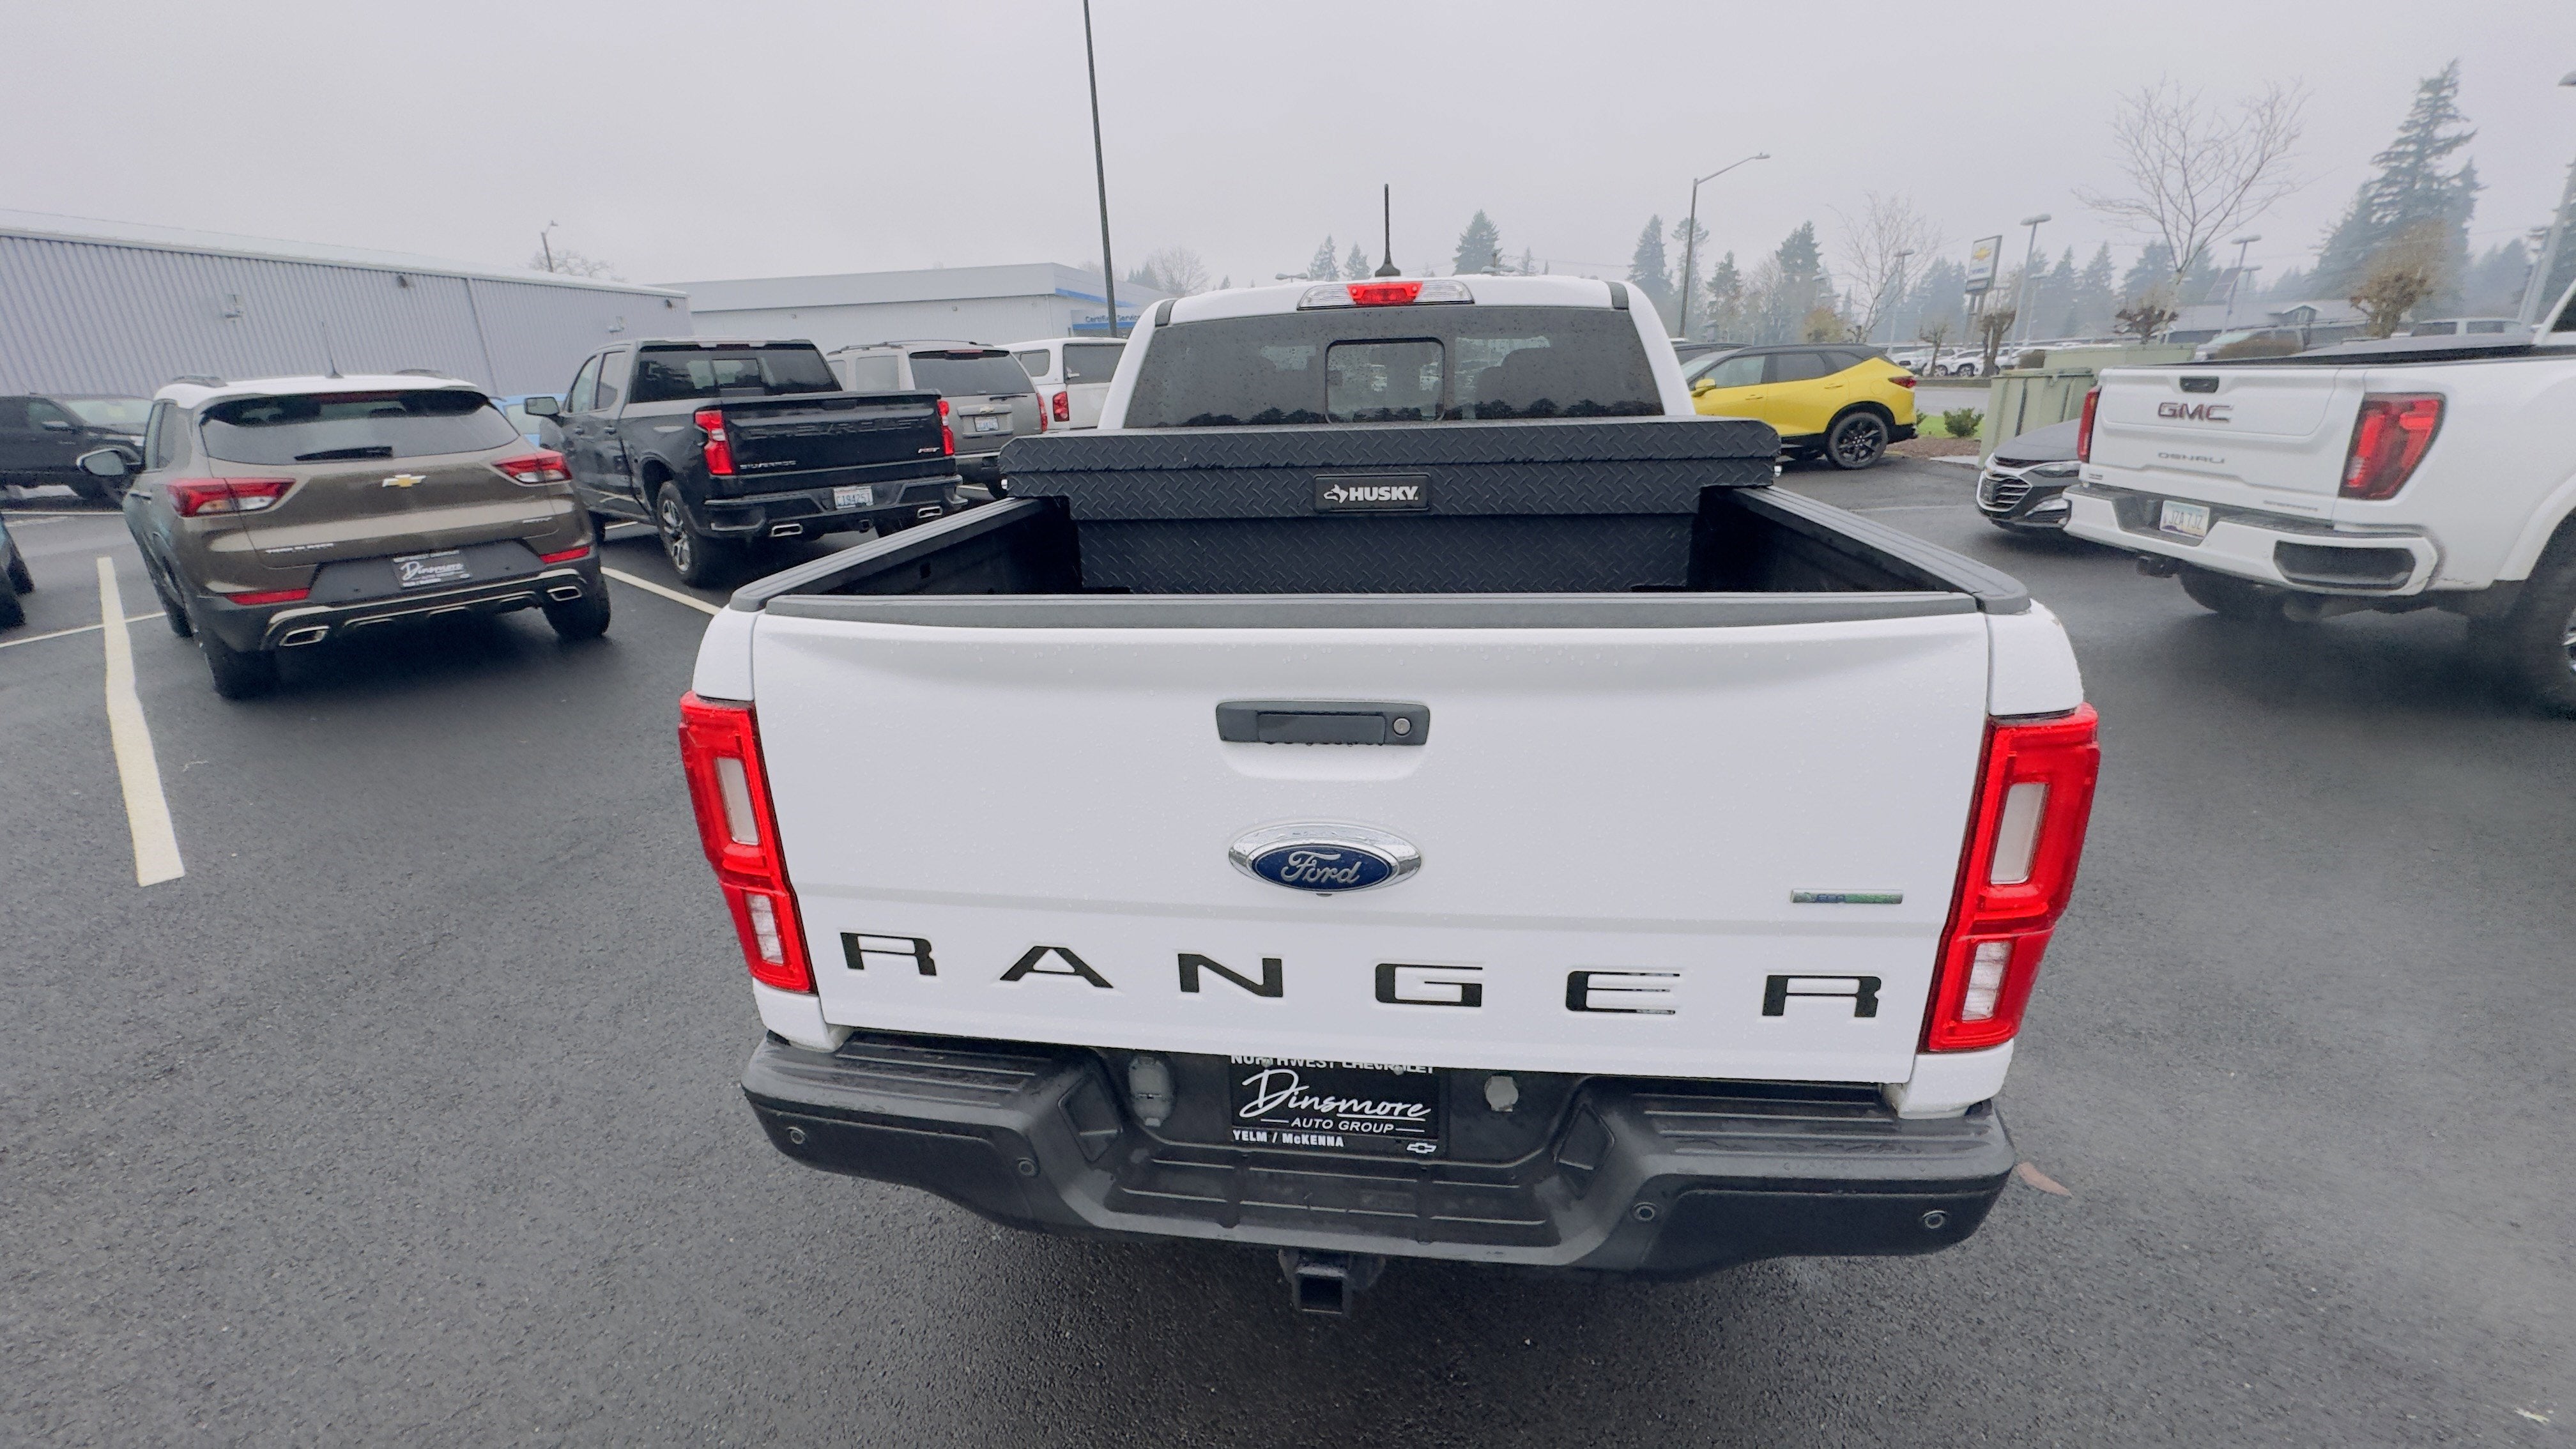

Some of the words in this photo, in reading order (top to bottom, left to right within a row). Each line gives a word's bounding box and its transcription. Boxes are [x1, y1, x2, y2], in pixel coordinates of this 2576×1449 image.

[1085, 314, 1109, 323] Certifi
[2158, 401, 2234, 423] GMC
[1280, 850, 1362, 884] Ford
[839, 931, 1882, 1018] RANGER
[1342, 1061, 1434, 1075] CHEVRLET
[1239, 1068, 1432, 1118] Dinsmore
[1291, 1117, 1333, 1130] AUTO
[1338, 1121, 1395, 1133] GROUP
[1232, 1130, 1268, 1142] YELM
[1282, 1133, 1345, 1147] McKENNA
